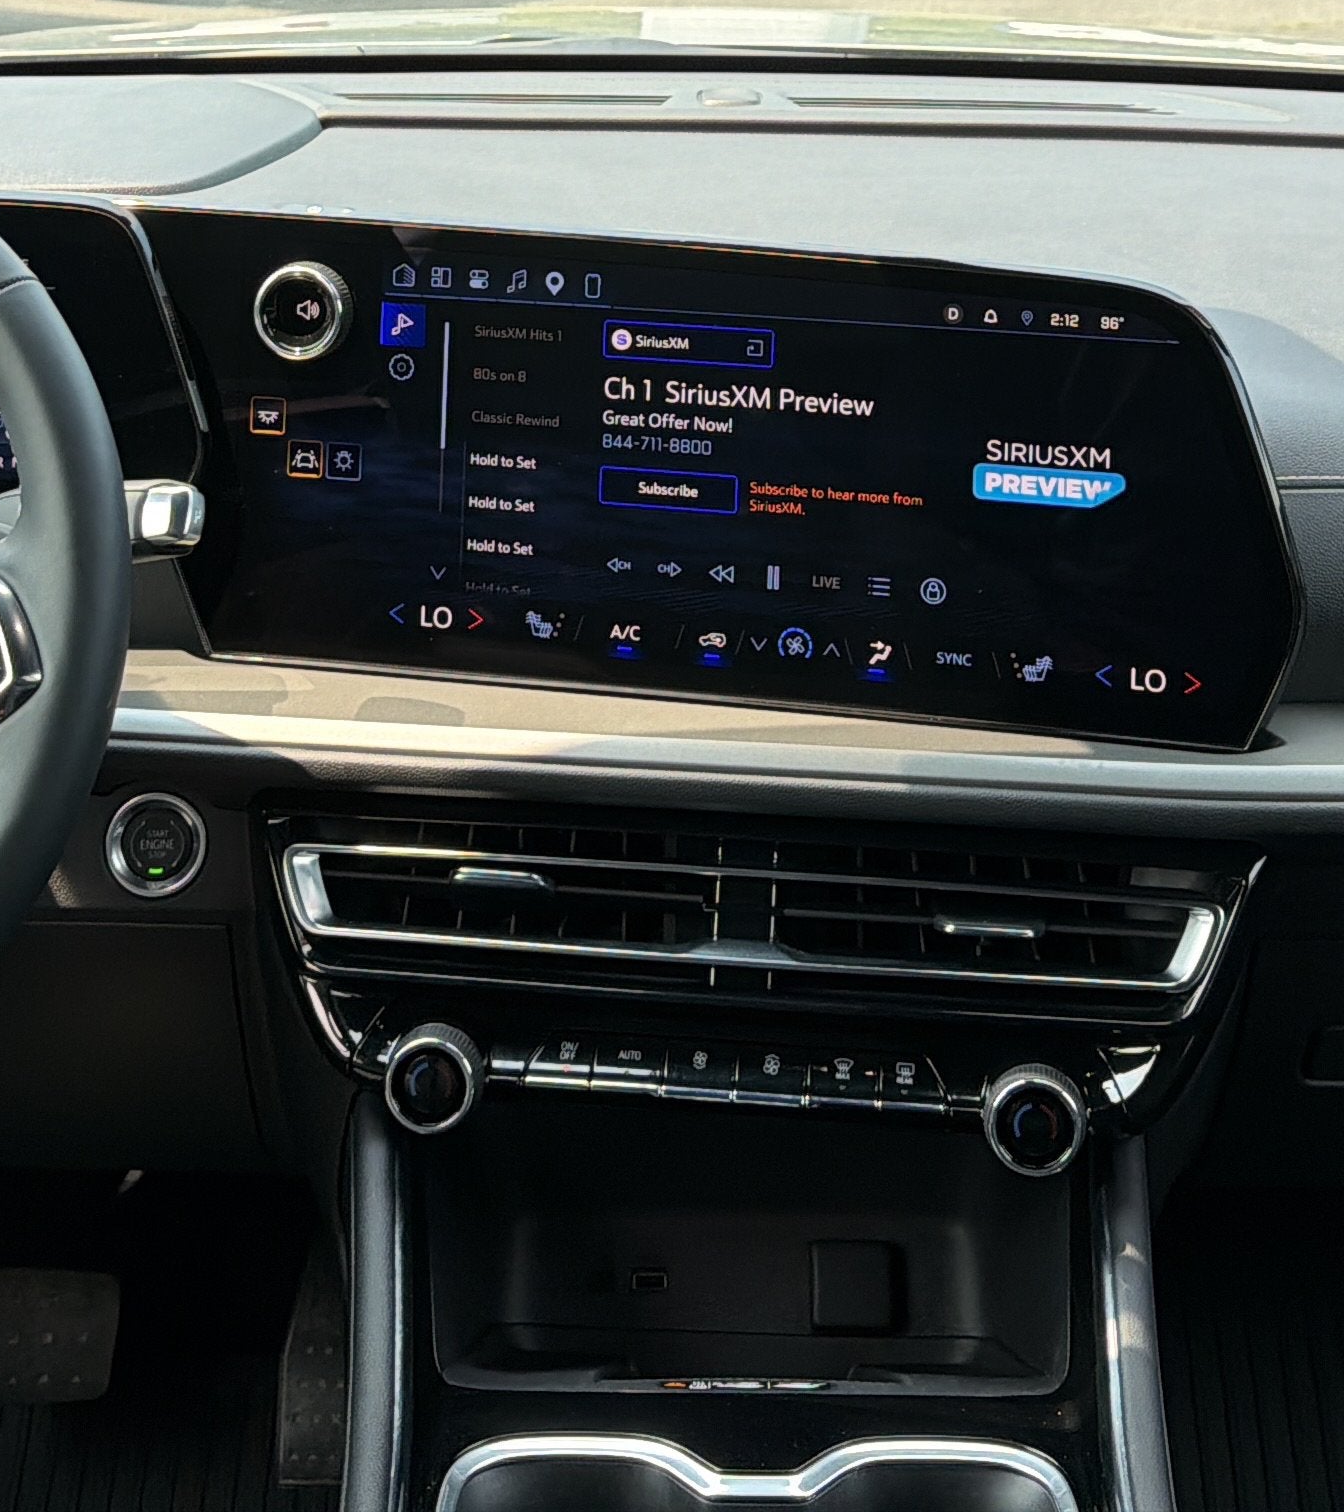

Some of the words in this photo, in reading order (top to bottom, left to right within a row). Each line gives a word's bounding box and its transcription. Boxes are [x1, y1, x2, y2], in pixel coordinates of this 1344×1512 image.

[1049, 312, 1080, 329] 2:12
[1099, 315, 1126, 331] 96°
[474, 325, 528, 341] SiriusXM
[529, 328, 554, 342] Hits
[635, 334, 690, 350] SiriusXM
[472, 367, 496, 383] 80s
[497, 371, 515, 383] on
[517, 369, 528, 384] 8
[603, 376, 635, 402] Ch
[642, 378, 652, 402] 1
[664, 380, 772, 411] SiriusXM
[778, 389, 876, 418] Preview
[471, 410, 515, 426] Classic
[515, 412, 560, 429] Rewind
[602, 409, 646, 428] Great
[648, 411, 691, 431] Offer
[693, 415, 735, 435] Now!
[602, 433, 713, 457] 844-711-8800
[985, 438, 1112, 471] SIRIUSXM
[469, 452, 499, 468] Hold
[500, 454, 513, 469] to
[515, 455, 537, 471] Set
[637, 480, 699, 499] Subscribe
[749, 480, 809, 499] Subscribe
[811, 486, 825, 500] to
[827, 486, 856, 503] hear
[857, 491, 891, 505] more
[892, 491, 924, 507] from
[984, 470, 1113, 501] PREVIEW
[468, 495, 498, 511] Hold
[498, 497, 512, 512] to
[514, 498, 536, 514] Set
[748, 499, 807, 516] SiriusXM.
[466, 538, 496, 554] Hold
[497, 540, 511, 555] to
[512, 541, 534, 557] Set
[811, 575, 842, 590] LIVE
[419, 604, 453, 630] LO
[609, 623, 642, 643] A/C
[935, 650, 973, 668] SYNC
[1130, 666, 1168, 693] LO
[139, 839, 176, 851] ENGINE
[559, 1049, 577, 1061] OFF
[560, 1040, 580, 1052] ON/
[617, 1049, 643, 1062] AUTO
